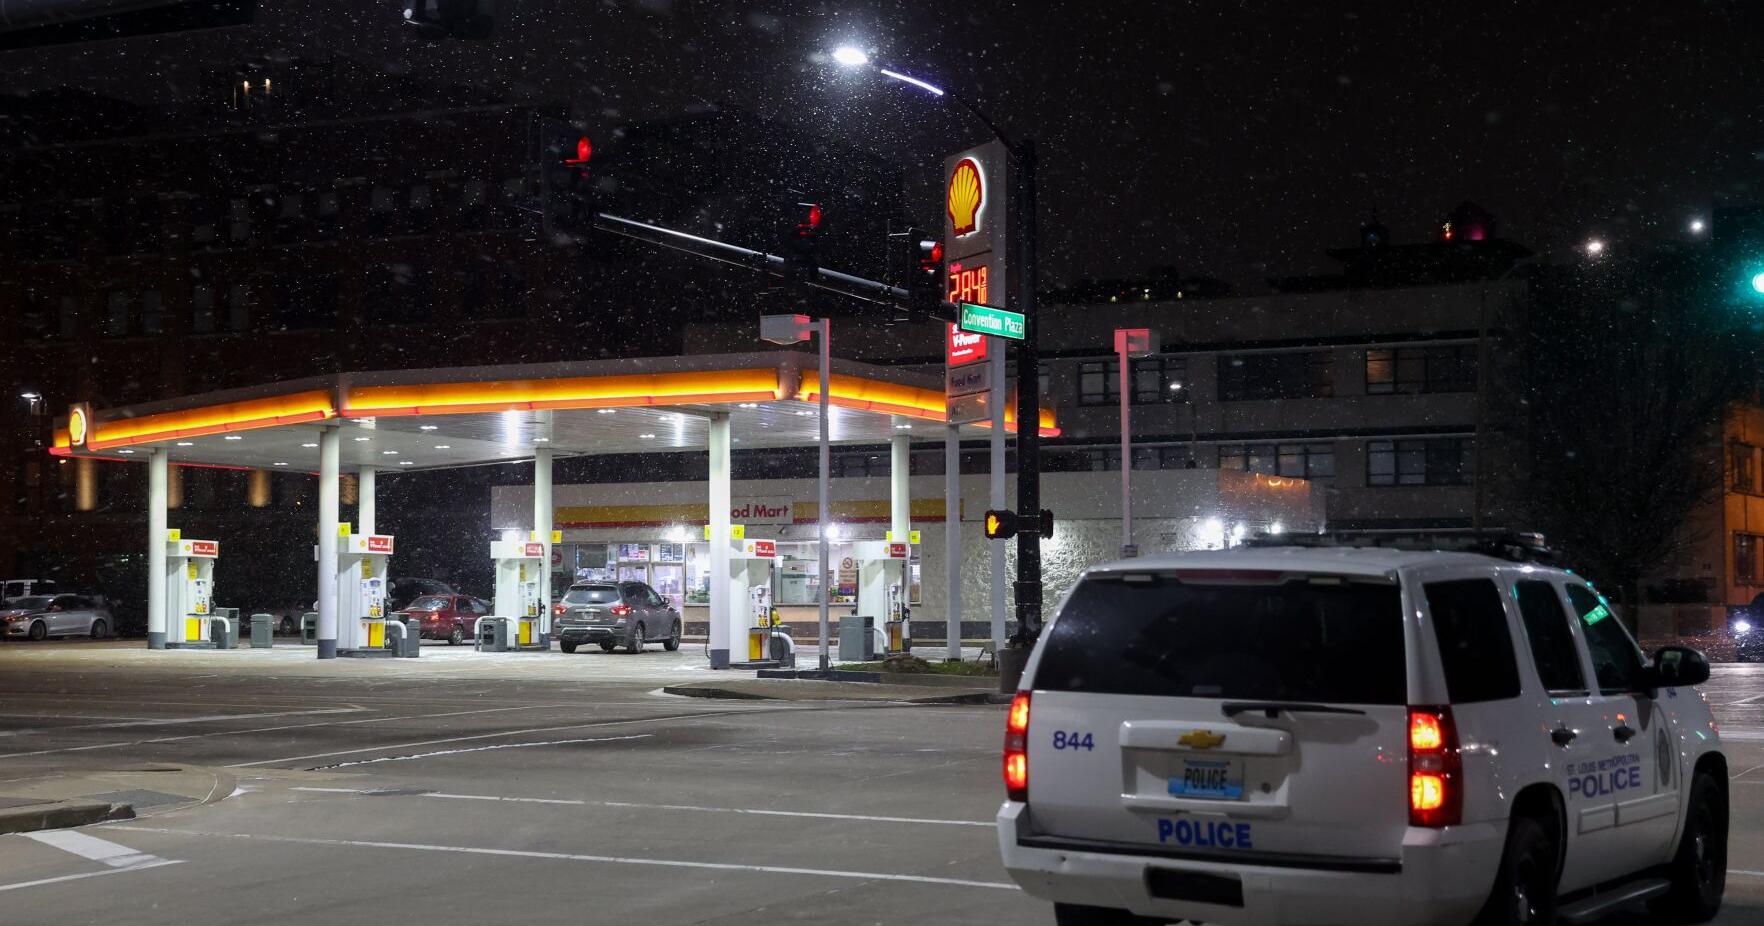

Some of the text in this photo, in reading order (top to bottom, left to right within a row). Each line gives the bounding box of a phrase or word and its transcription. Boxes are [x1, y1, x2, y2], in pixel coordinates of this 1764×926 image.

[963, 309, 1002, 331] Convention
[1005, 317, 1023, 334] Plaza
[731, 504, 788, 518] od Mart
[1053, 731, 1094, 751] 844
[1184, 768, 1227, 790] POLICE
[1568, 766, 1641, 799] POLICE
[1158, 818, 1252, 848] POLICE
